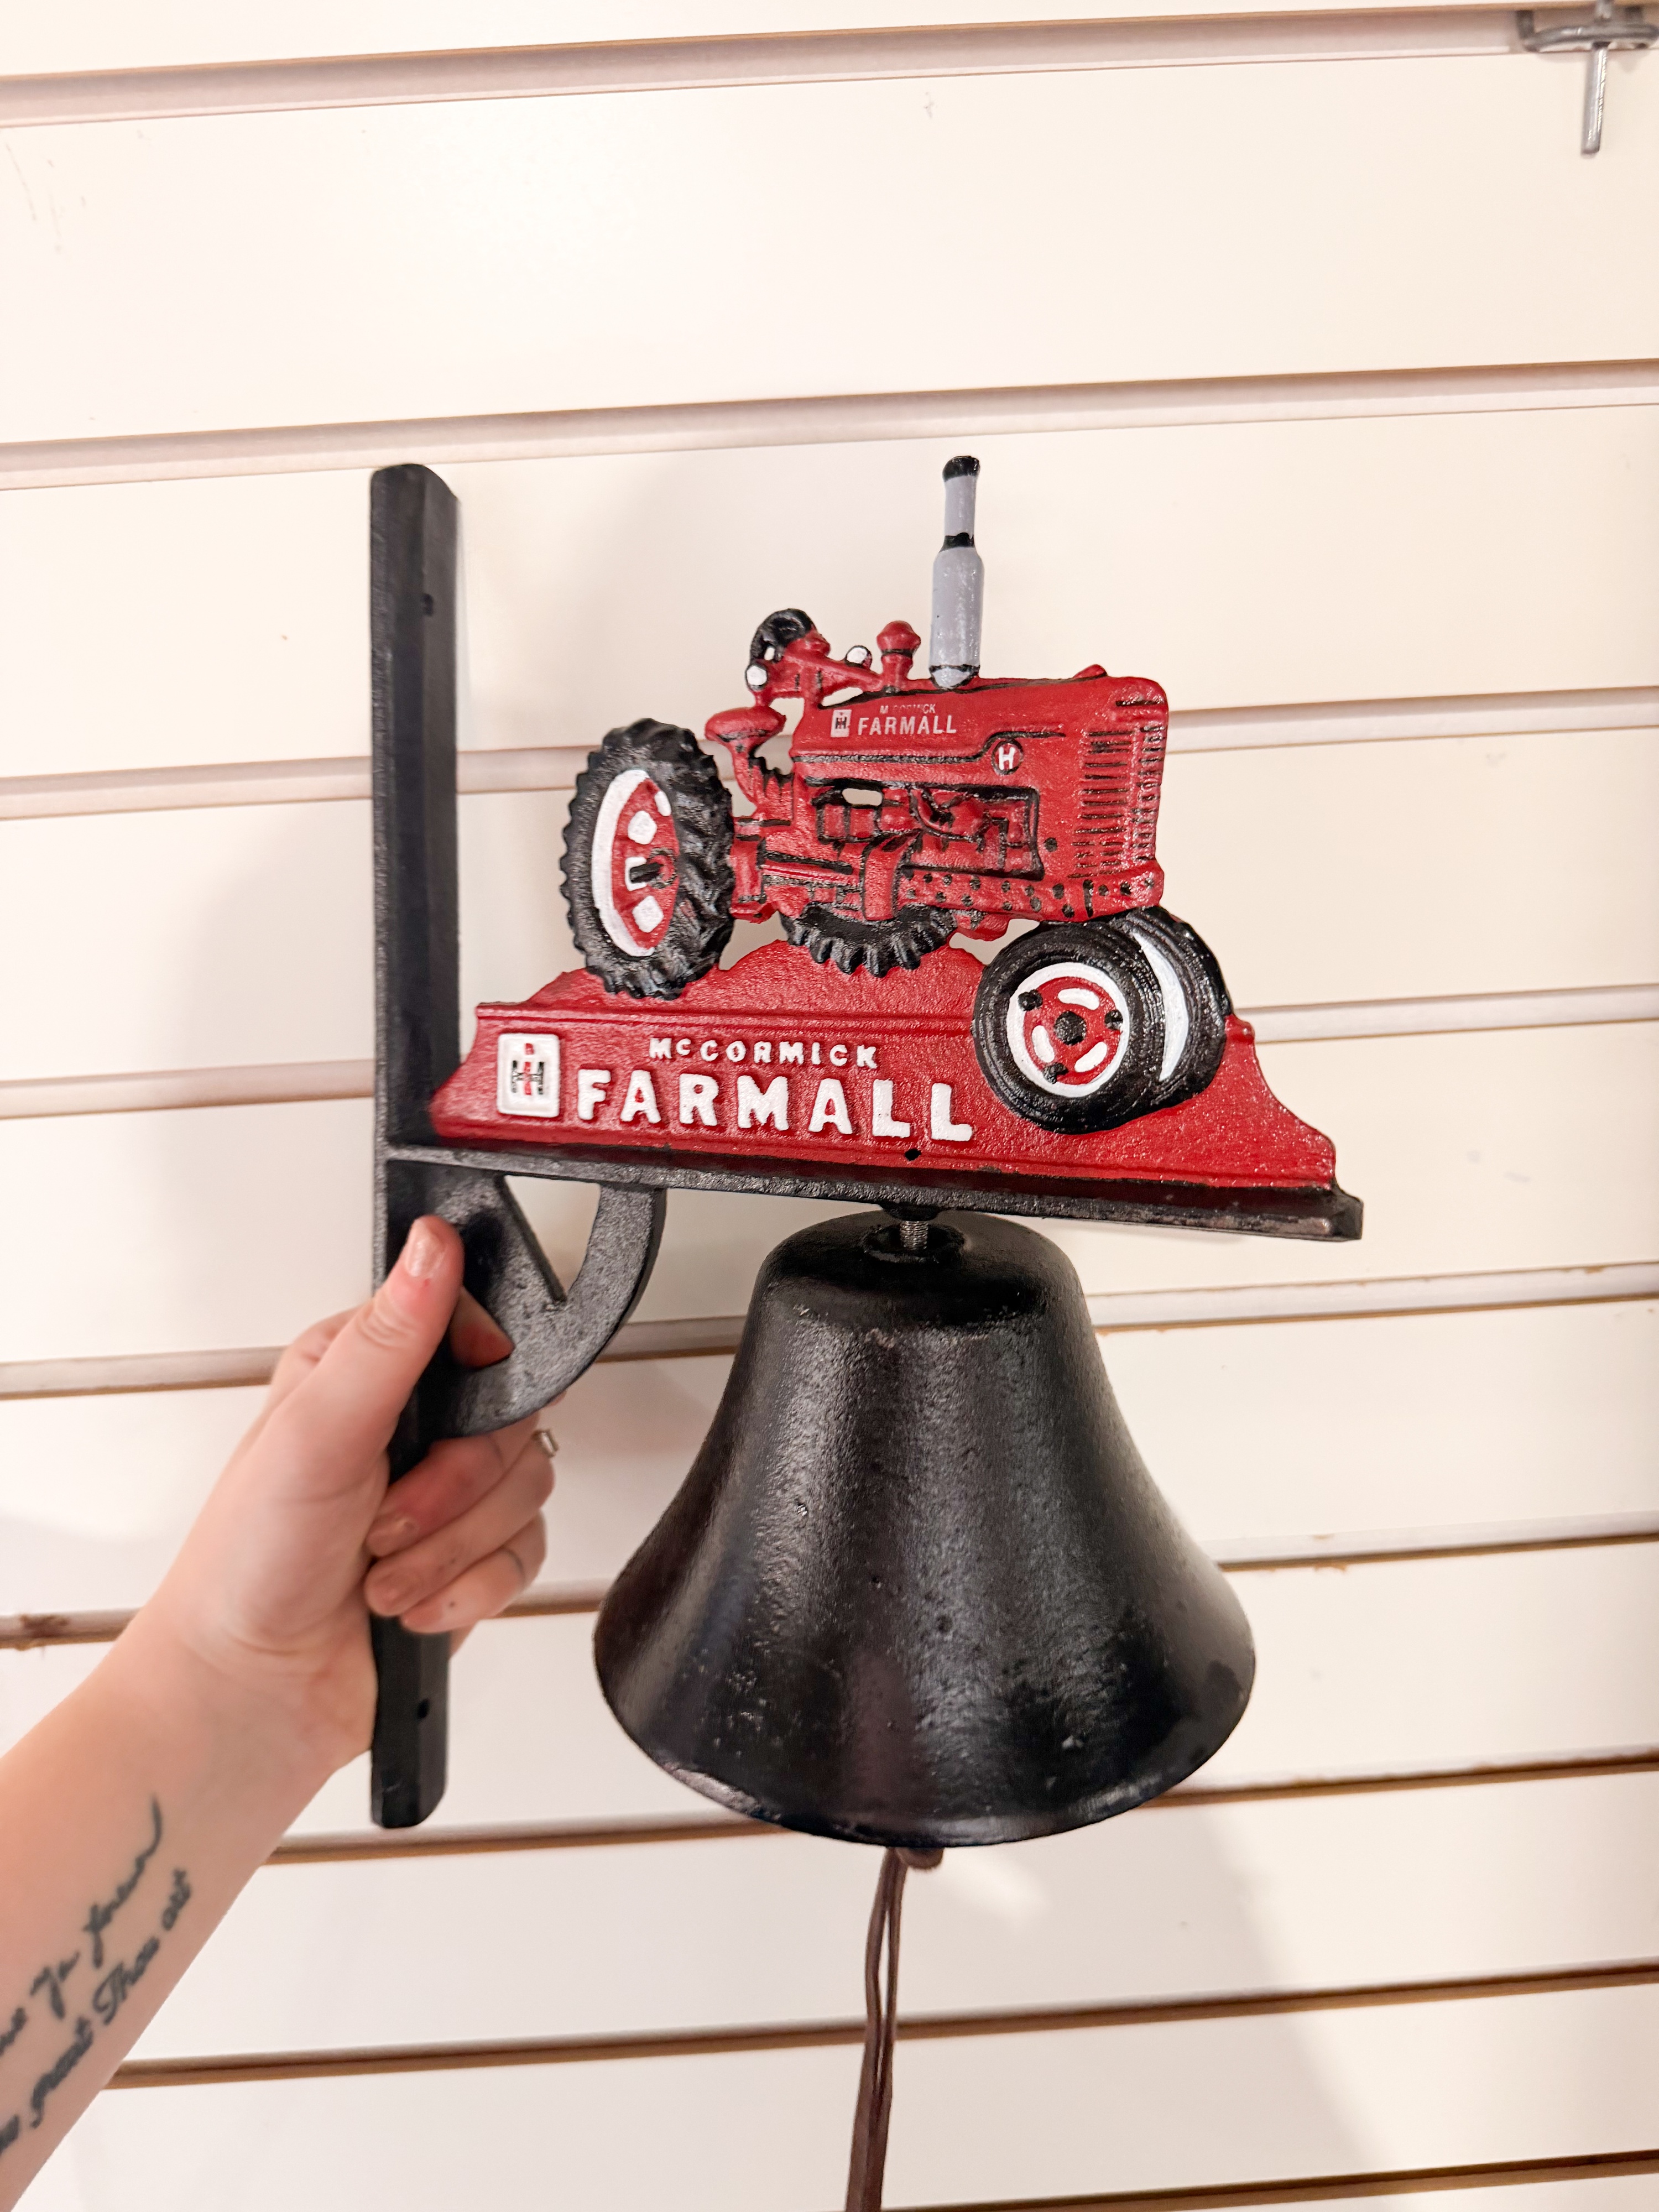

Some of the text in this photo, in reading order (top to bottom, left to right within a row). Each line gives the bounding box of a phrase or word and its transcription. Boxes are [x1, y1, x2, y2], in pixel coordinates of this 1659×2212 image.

[857, 714, 957, 735] FARMALL
[998, 747, 1016, 770] H
[577, 1069, 973, 1141] FARMALL
